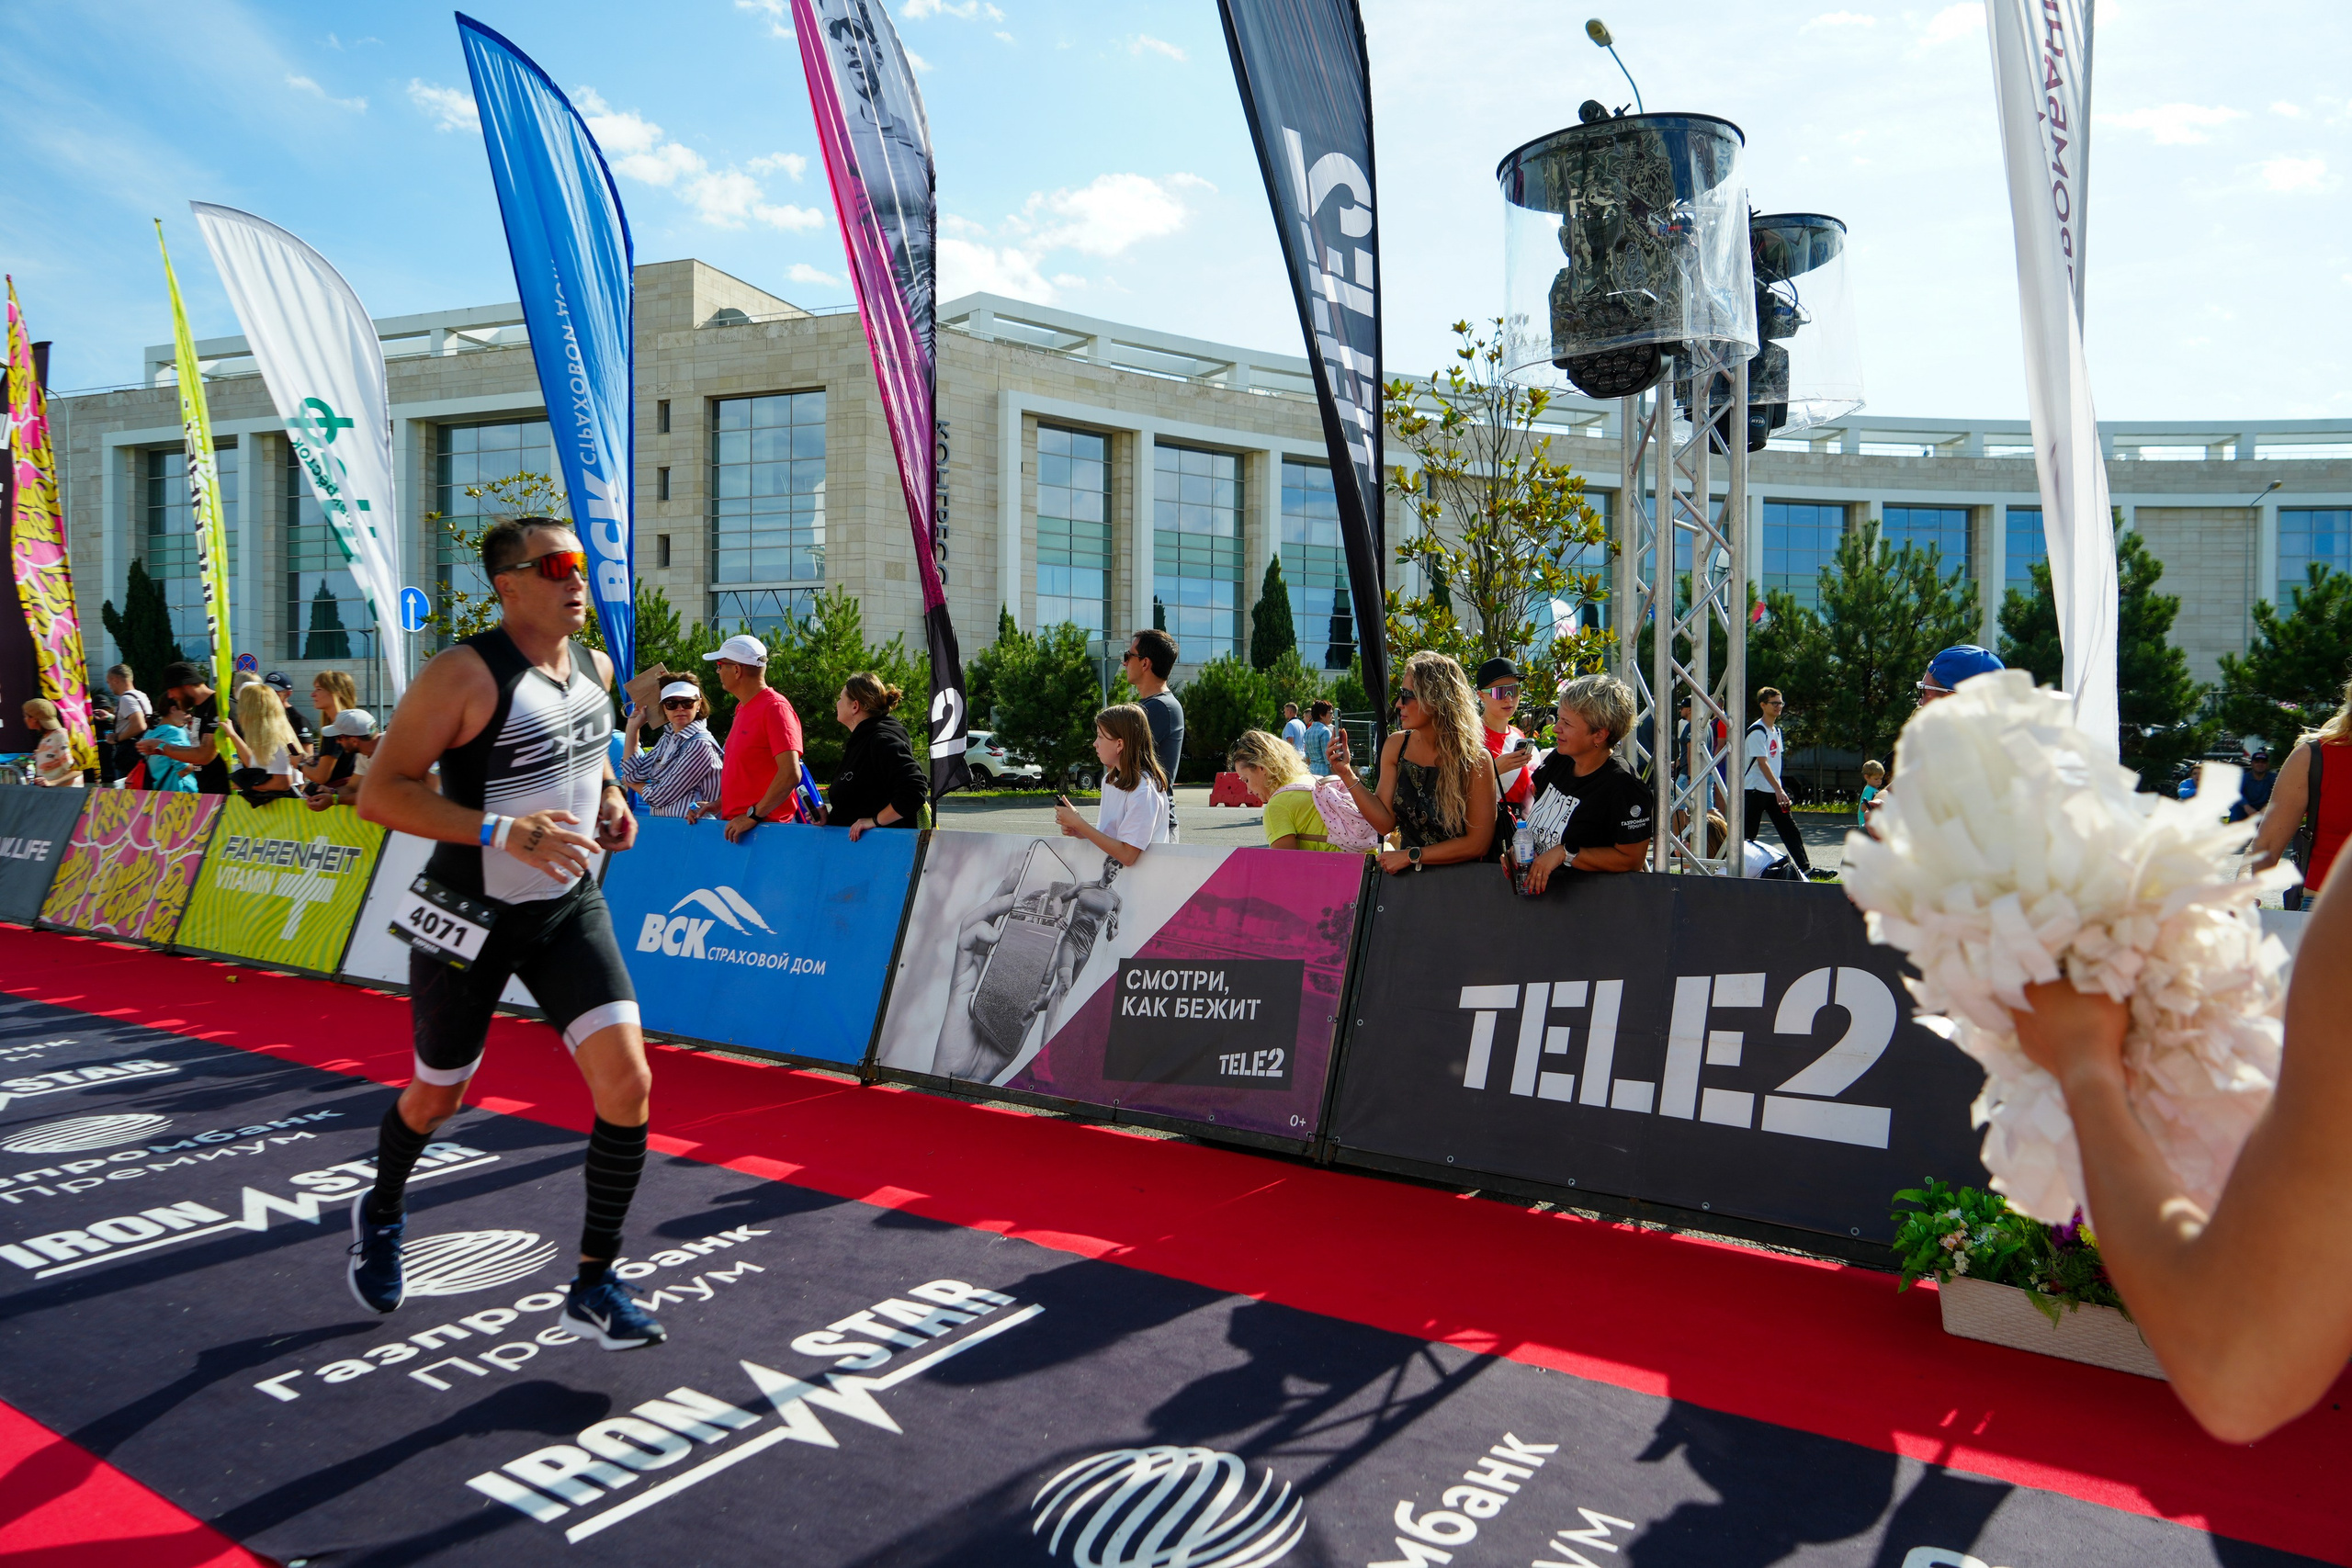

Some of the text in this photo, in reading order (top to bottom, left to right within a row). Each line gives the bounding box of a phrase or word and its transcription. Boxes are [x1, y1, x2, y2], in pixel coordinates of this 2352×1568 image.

[220, 835, 363, 874] FAHRENHEIT
[215, 864, 276, 895] VITAMIN
[410, 905, 469, 947] 4071
[636, 913, 715, 959] ВСК
[707, 946, 826, 976] СТРАХОВОЙ ДОМ
[1125, 969, 1230, 995] СМОТРИ,
[1122, 996, 1261, 1021] КАК БЕЖИТ
[1219, 1047, 1284, 1077] TELE2
[1458, 966, 1898, 1150] TELE2
[1289, 1114, 1306, 1128] 0+
[0, 1201, 229, 1269] IRON
[253, 1224, 772, 1402] Газпробанк
[408, 1259, 765, 1391] Преиум
[465, 1279, 1018, 1523] IRON STAR
